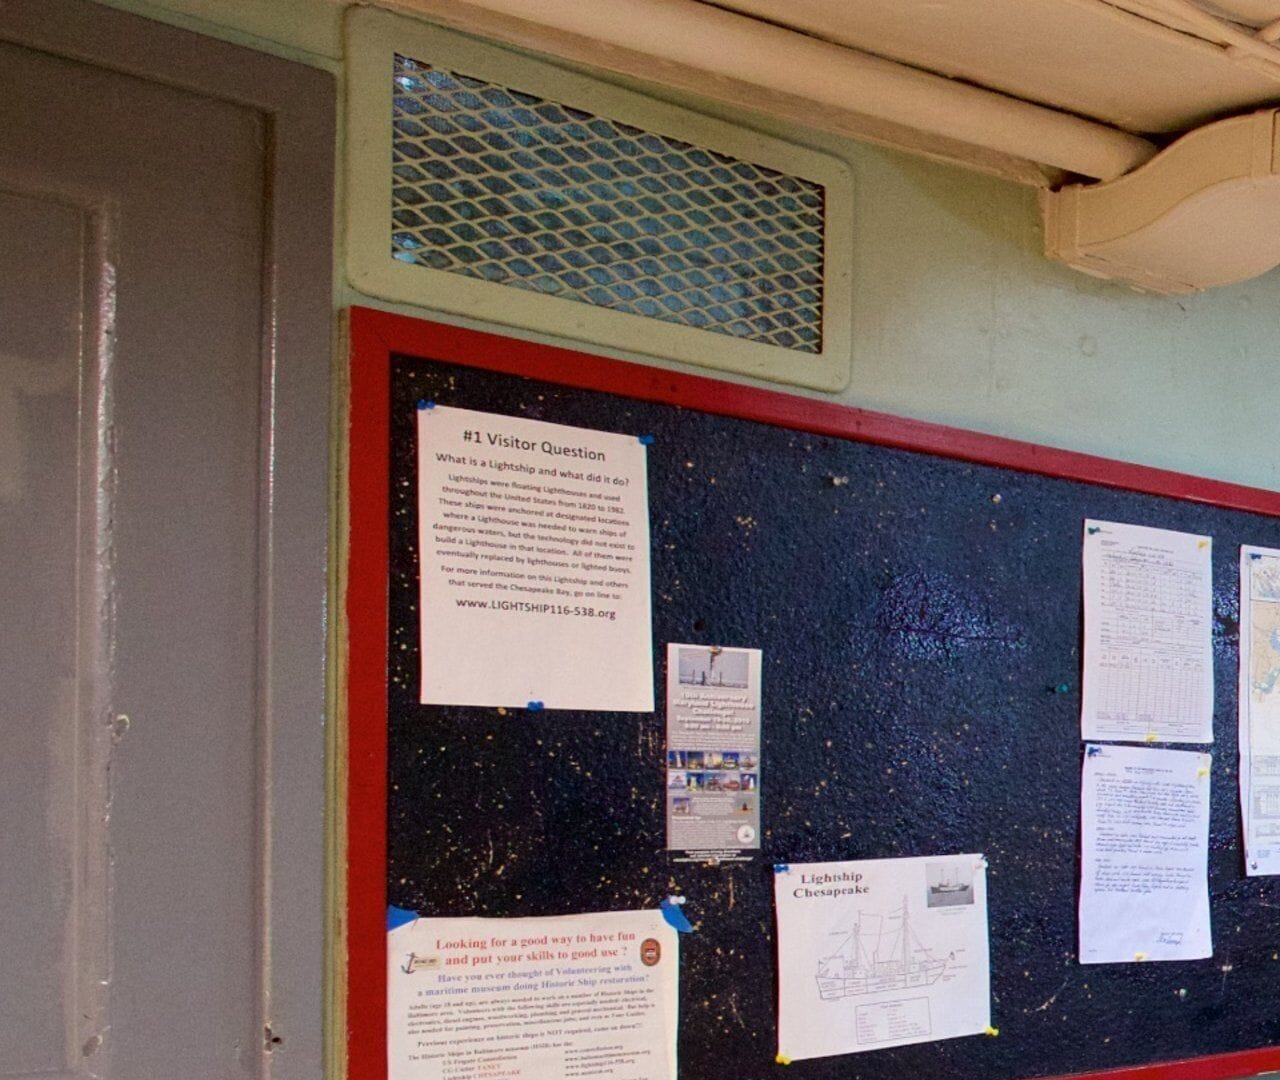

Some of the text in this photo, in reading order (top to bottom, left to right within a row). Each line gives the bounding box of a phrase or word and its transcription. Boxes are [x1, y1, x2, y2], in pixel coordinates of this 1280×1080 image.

[462, 428, 606, 462] #1 Visitor Question
[435, 452, 629, 487] What is a Lightship and what did it do?
[454, 596, 616, 619] www.LIGHTSHIP116-538.org
[801, 873, 863, 886] Lightship
[793, 886, 870, 899] Chesapeake
[434, 930, 636, 952] Looking for a good way to have fun
[444, 954, 469, 965] and
[470, 954, 493, 966] put
[495, 953, 524, 963] your
[525, 949, 555, 961] skills
[557, 950, 569, 959] to
[570, 948, 598, 959] good
[600, 948, 618, 957] use
[437, 963, 632, 983] Have you ever thought of Volunteering with
[424, 986, 468, 996] maritime
[470, 984, 511, 993] museum
[512, 981, 539, 992] doing
[540, 978, 575, 988] Historic
[577, 977, 597, 987] Ship
